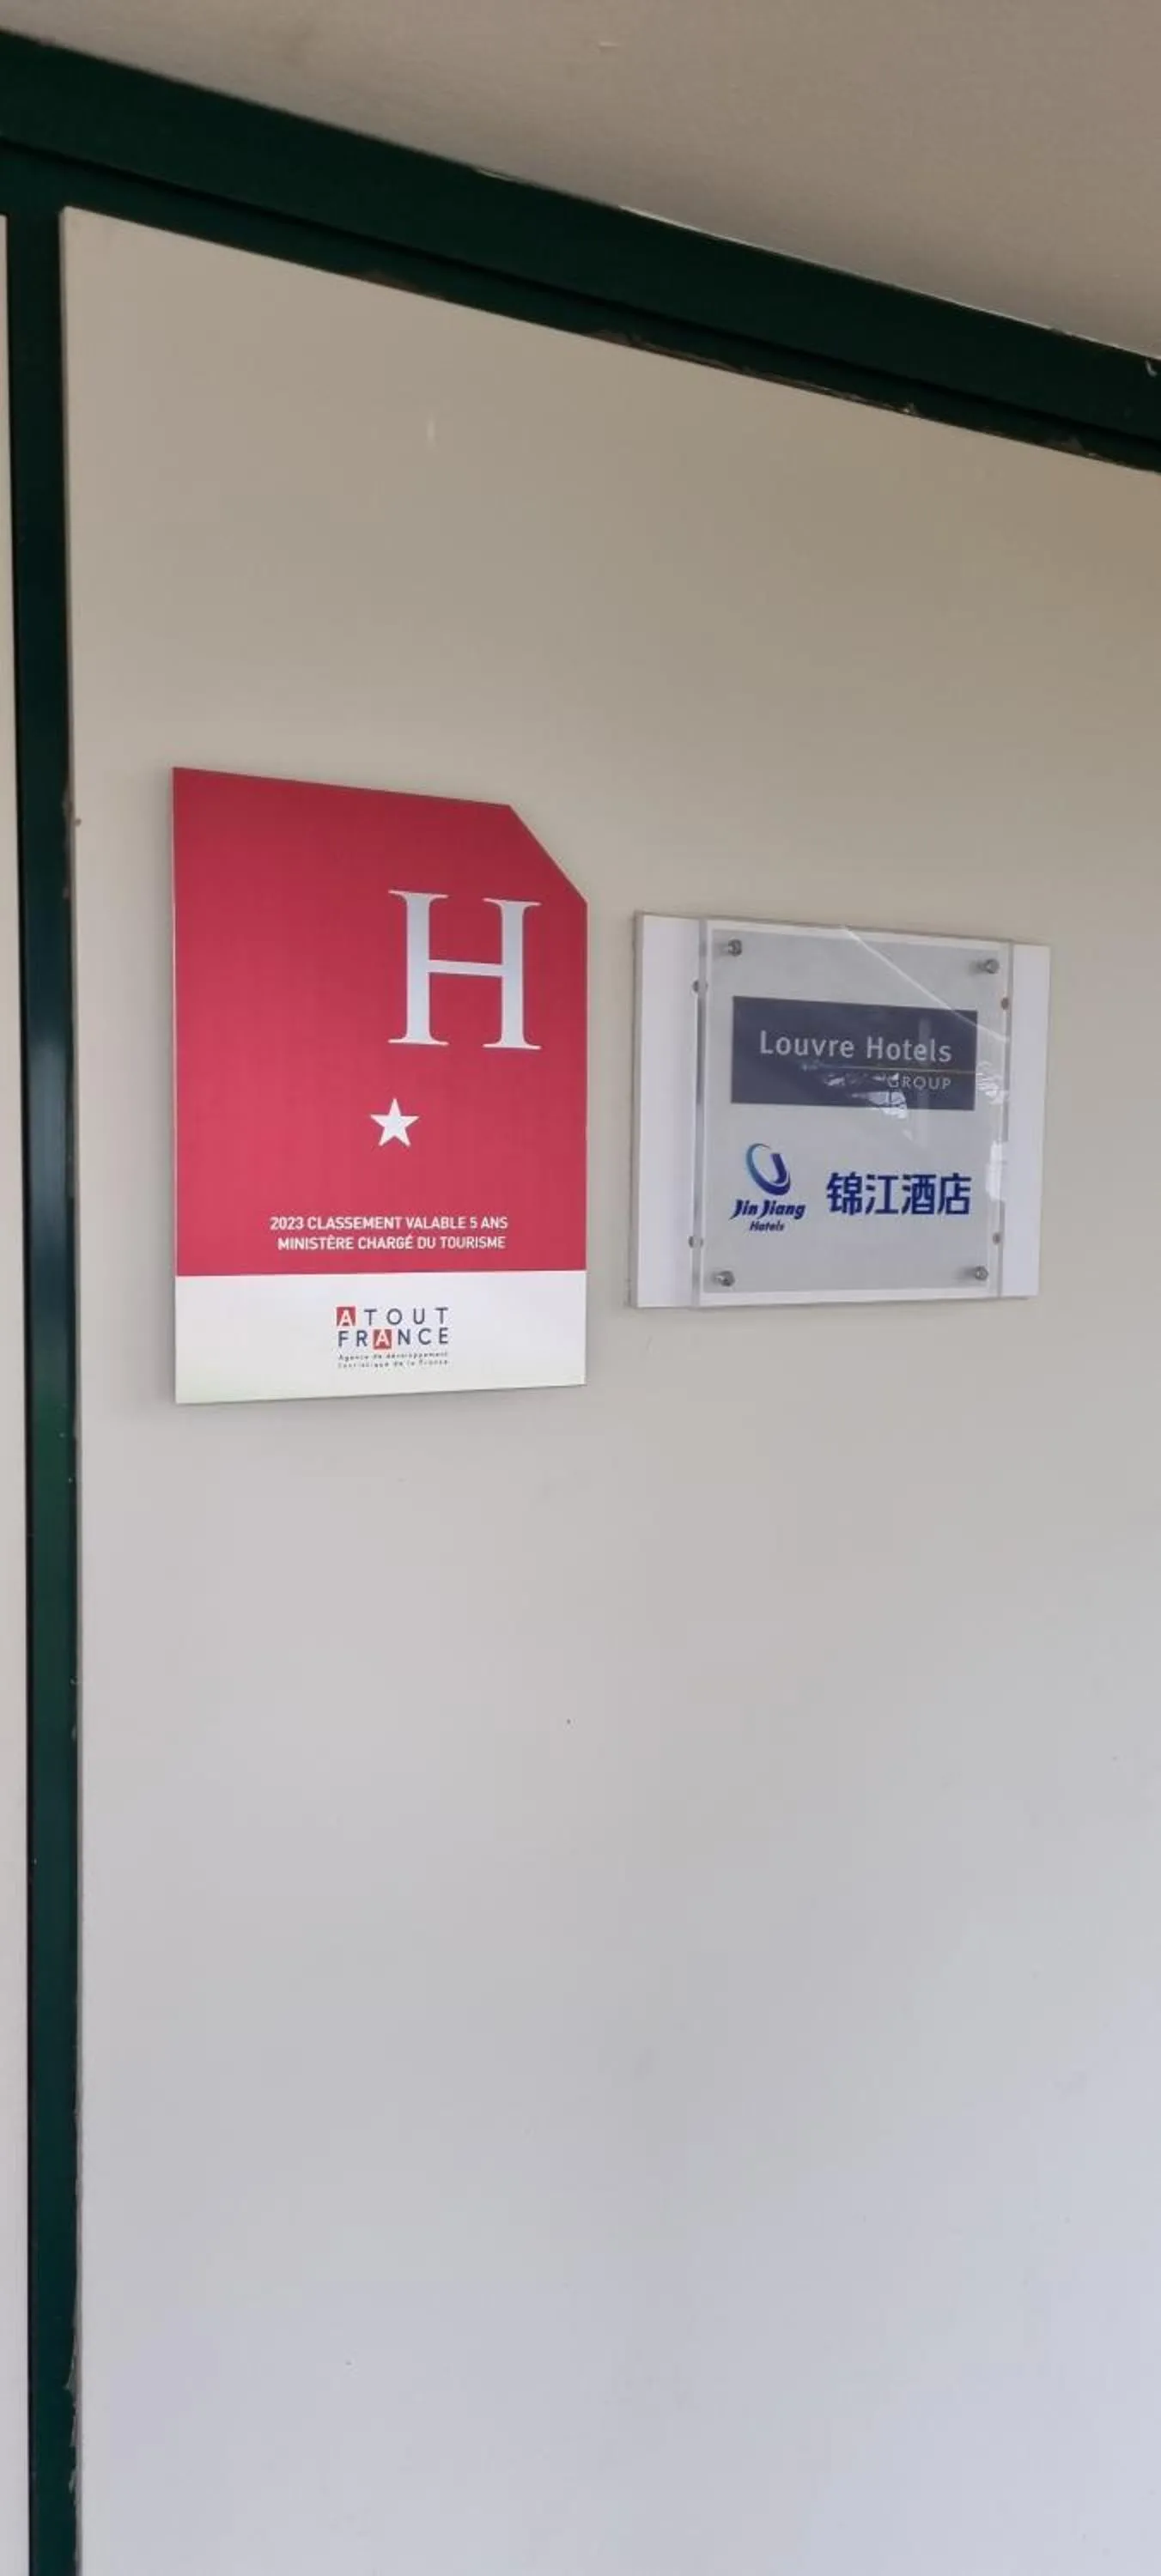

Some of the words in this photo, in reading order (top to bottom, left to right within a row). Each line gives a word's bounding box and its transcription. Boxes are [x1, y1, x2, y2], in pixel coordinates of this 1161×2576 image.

[388, 890, 542, 1050] H
[760, 1030, 855, 1059] Louvre
[866, 1036, 952, 1062] Hotels
[887, 1075, 951, 1090] GROUP
[826, 1171, 972, 1216] 锦江酒店
[729, 1200, 757, 1220] Jin
[757, 1200, 806, 1220] Jiang
[270, 1216, 304, 1230] 2023
[307, 1216, 402, 1230] CLASSEMENT
[405, 1216, 465, 1229] VALABLE
[469, 1217, 477, 1229] 5
[481, 1215, 508, 1229] ANS
[749, 1219, 786, 1232] Hotels
[277, 1235, 353, 1251] MINISTÈRE
[357, 1236, 414, 1250] CHARGÉ
[417, 1236, 436, 1249] DU
[440, 1236, 506, 1249] TOURISME
[337, 1306, 449, 1327] ATOUT
[337, 1327, 449, 1350] FRANCE
